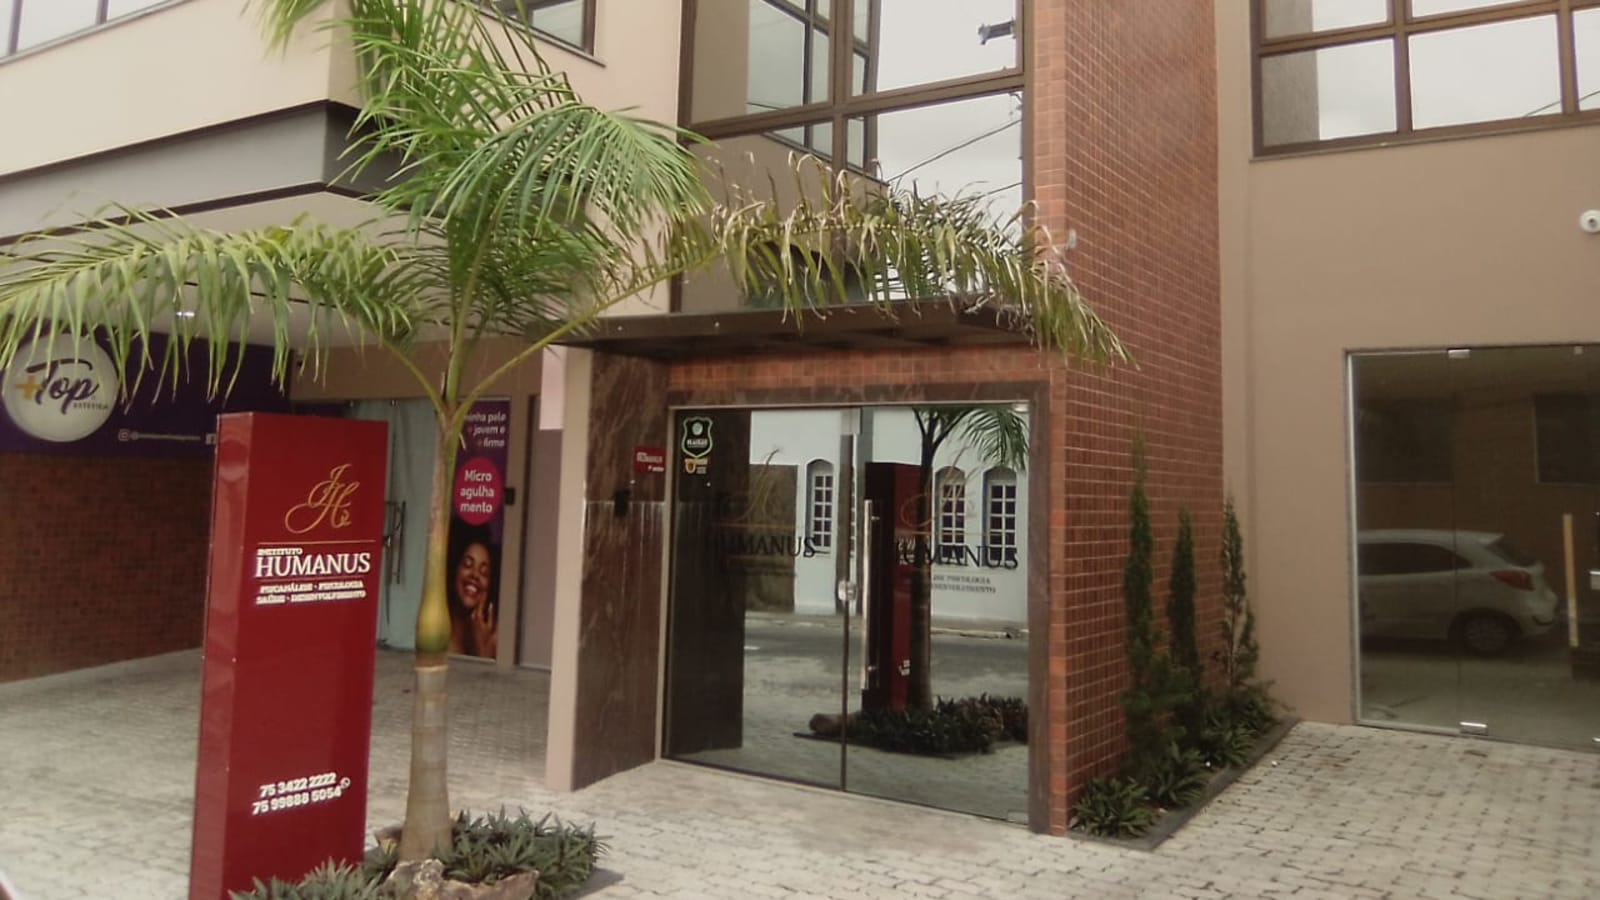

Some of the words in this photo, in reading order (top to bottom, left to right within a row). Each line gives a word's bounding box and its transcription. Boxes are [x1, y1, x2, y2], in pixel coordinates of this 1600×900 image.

[464, 469, 493, 482] Micro
[460, 486, 495, 500] agulha
[460, 502, 493, 514] mento
[255, 552, 371, 578] HUMANUS
[260, 784, 276, 798] 75
[278, 777, 308, 794] 3422
[309, 772, 337, 788] 2222
[252, 800, 269, 816] 75
